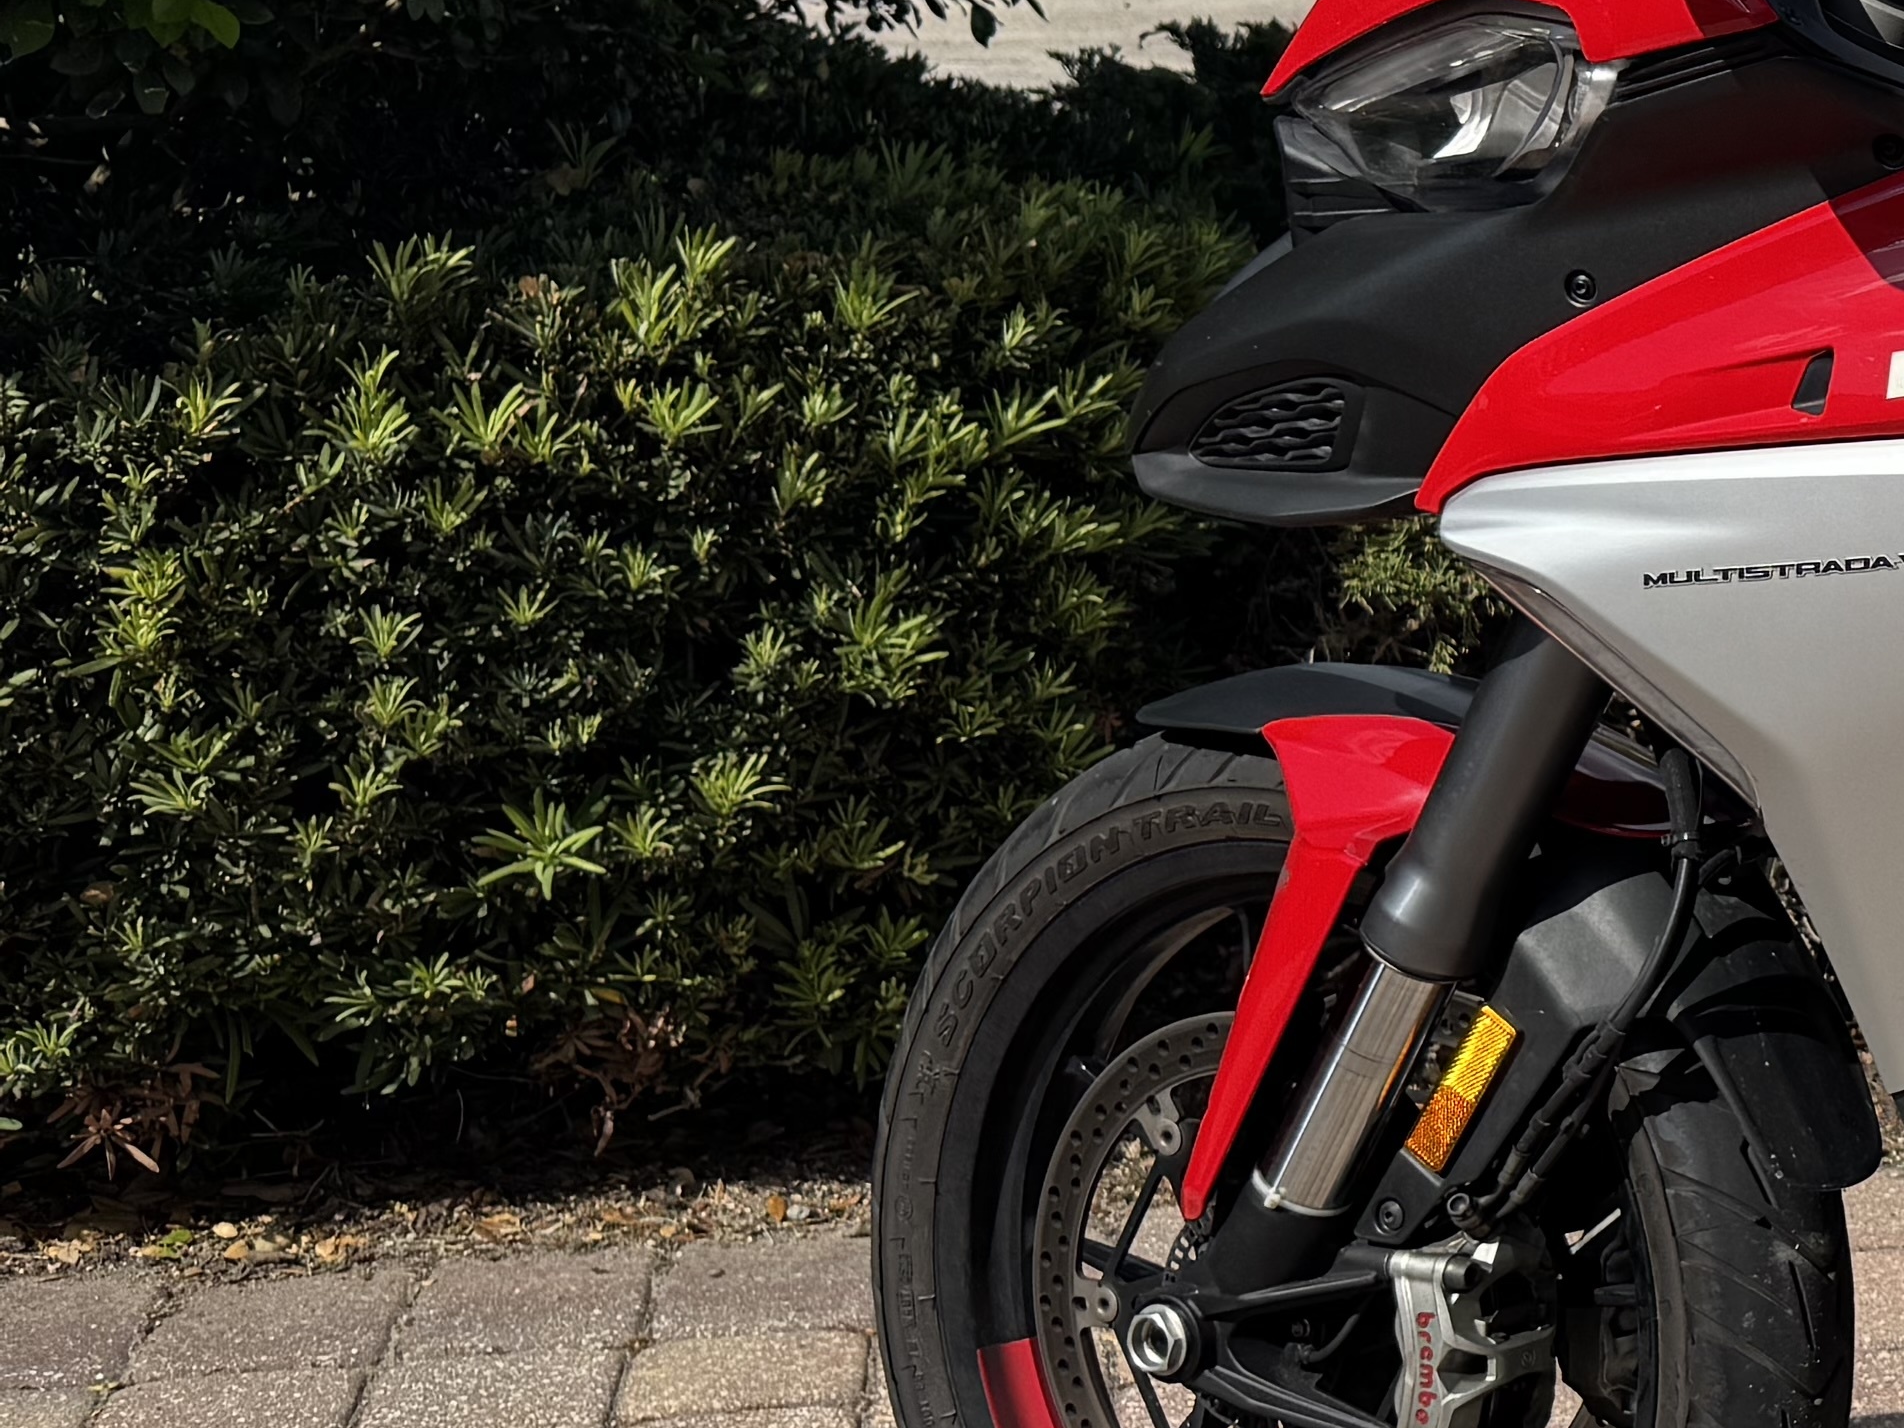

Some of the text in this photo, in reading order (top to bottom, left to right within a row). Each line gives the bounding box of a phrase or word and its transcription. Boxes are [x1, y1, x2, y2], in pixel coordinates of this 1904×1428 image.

[1642, 556, 1895, 589] MULTISTRADA
[933, 800, 1283, 1048] SCORPION TRAIL
[1415, 1312, 1438, 1425] brembo
